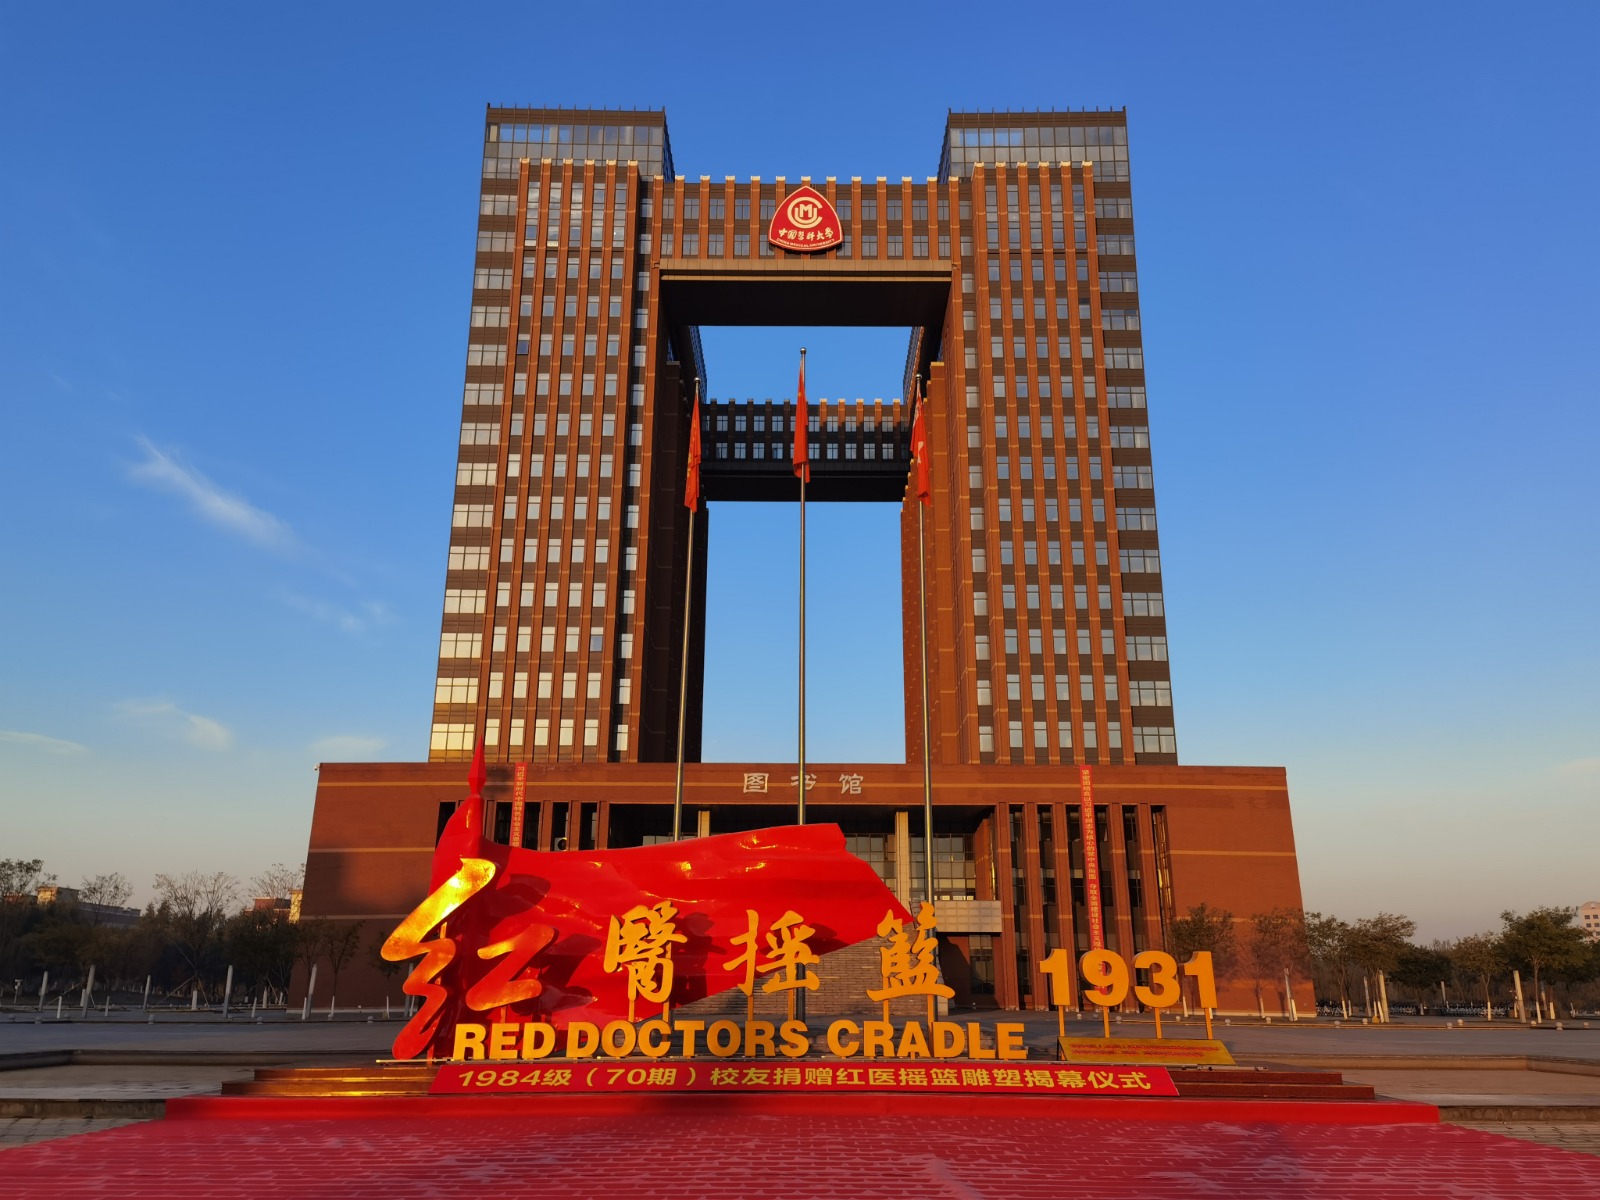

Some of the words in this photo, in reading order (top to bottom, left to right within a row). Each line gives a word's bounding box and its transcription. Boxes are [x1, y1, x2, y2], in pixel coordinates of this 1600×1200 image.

[743, 772, 864, 794] 图书馆
[1040, 948, 1218, 1008] 1931
[452, 1022, 556, 1060] RED
[566, 1020, 810, 1059] DOCTORS
[827, 1020, 1028, 1060] CRADLE
